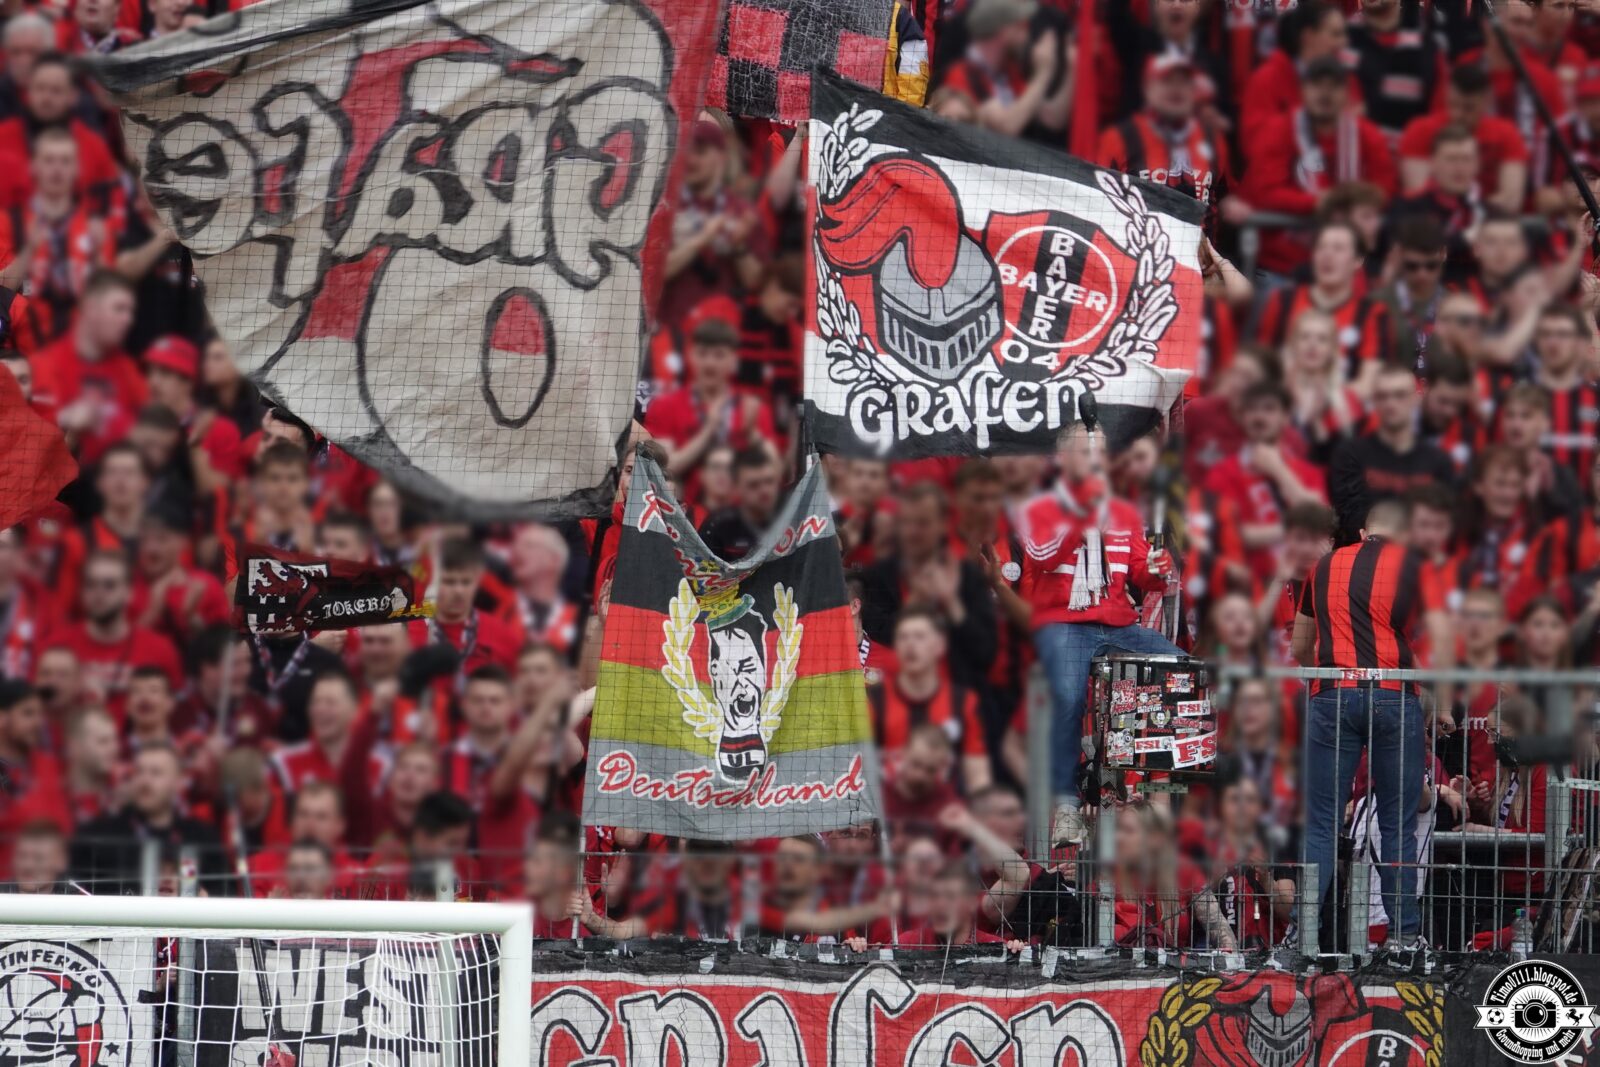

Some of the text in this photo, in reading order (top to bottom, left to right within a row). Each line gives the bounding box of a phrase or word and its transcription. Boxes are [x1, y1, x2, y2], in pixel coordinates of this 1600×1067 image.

[998, 263, 1108, 313] BAYER
[1031, 232, 1076, 341] BAYER
[1000, 339, 1061, 371] 04
